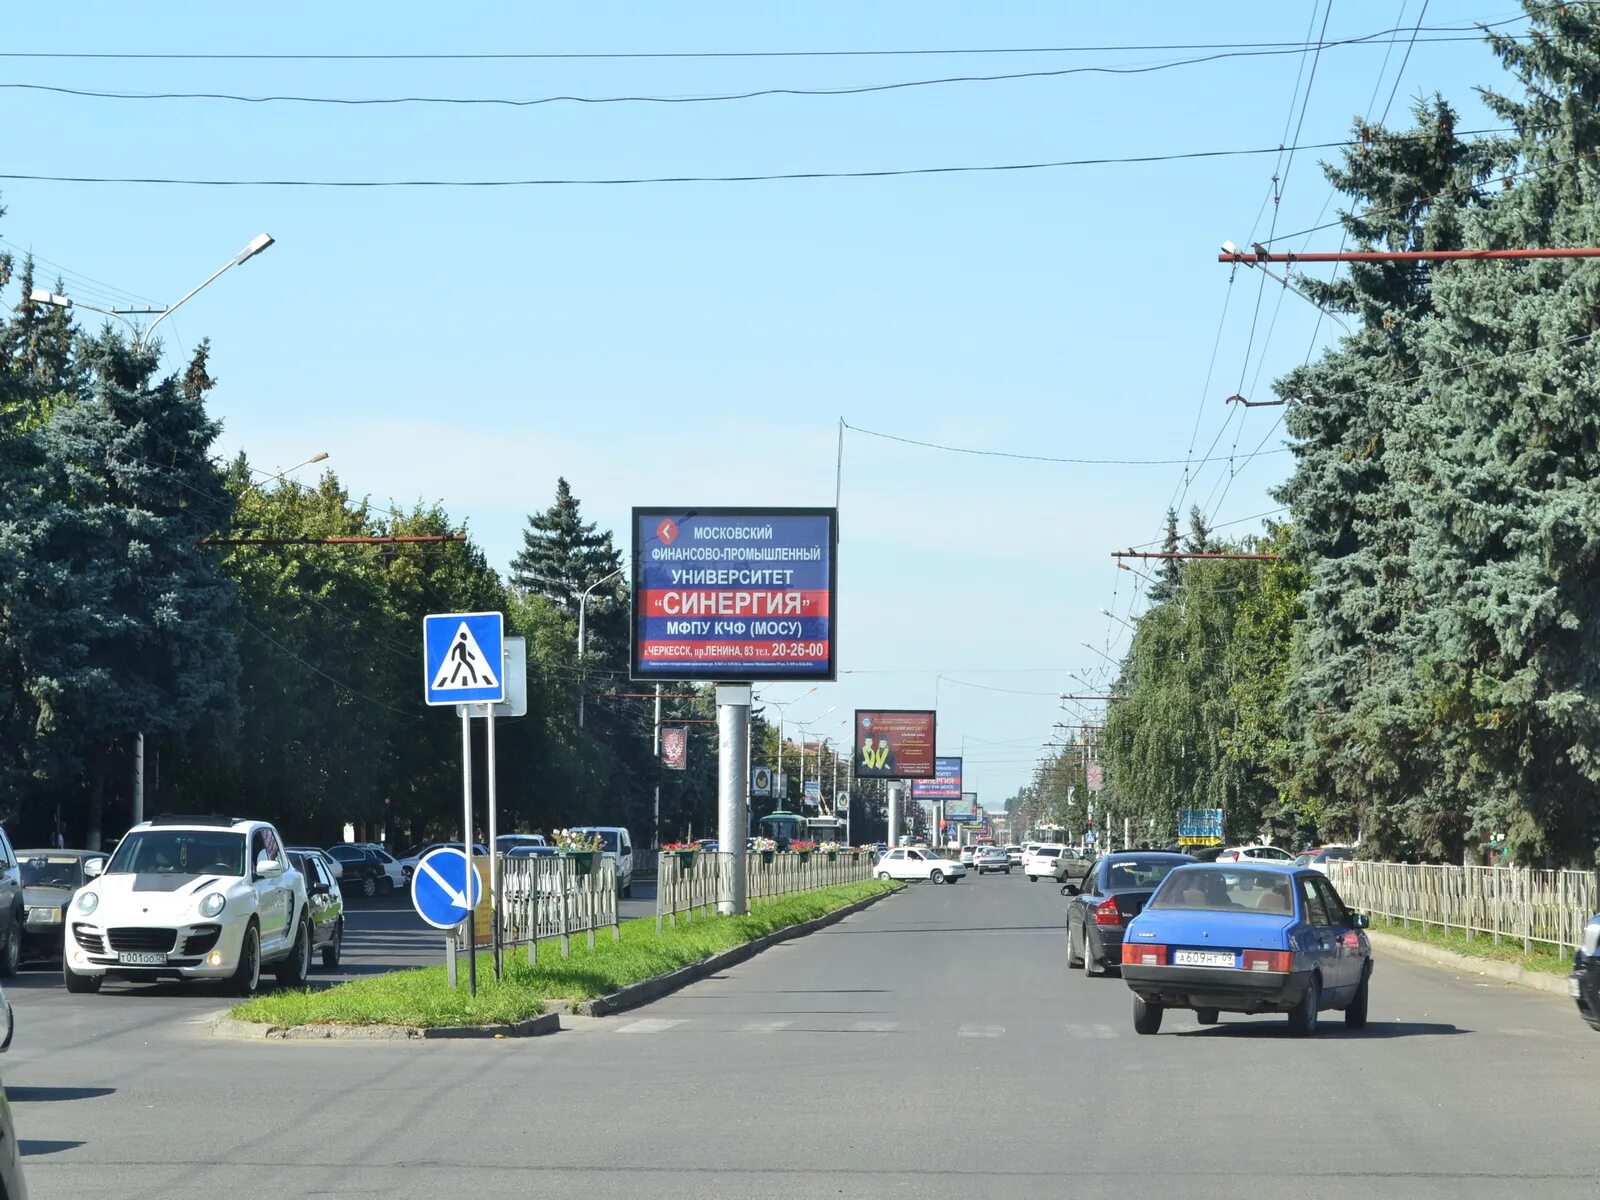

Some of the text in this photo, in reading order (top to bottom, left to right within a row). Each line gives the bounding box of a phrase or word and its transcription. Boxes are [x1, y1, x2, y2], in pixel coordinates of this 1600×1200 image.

[694, 524, 773, 540] МОСКОВСКИЙ
[651, 545, 821, 561] ФИНАНСОВО-ПРОМЫШЛЕННЫЙ
[671, 569, 794, 585] УНИВЕРСИТЕТ
[666, 621, 802, 638] МФПУ КЧФ (МОСУ)
[744, 645, 754, 656] 83
[755, 647, 770, 656] тел.
[772, 643, 823, 657] 20-26-00
